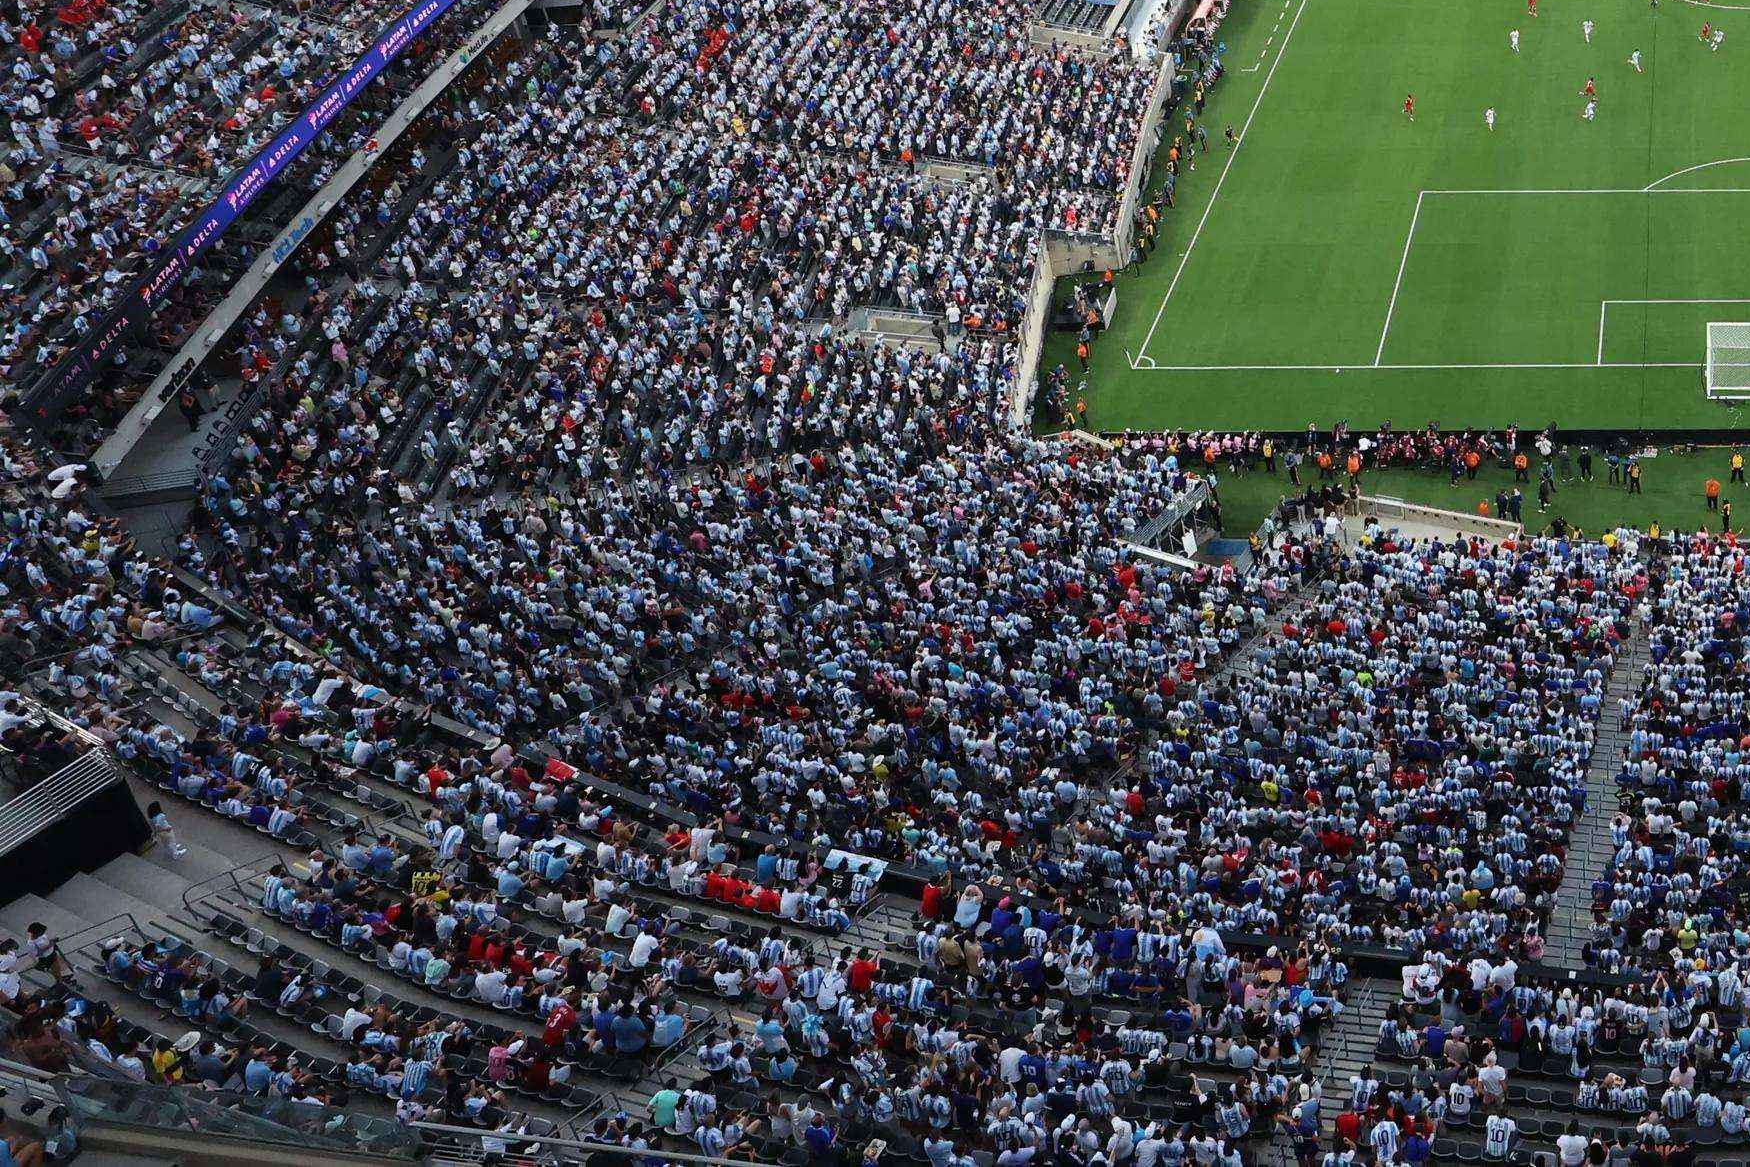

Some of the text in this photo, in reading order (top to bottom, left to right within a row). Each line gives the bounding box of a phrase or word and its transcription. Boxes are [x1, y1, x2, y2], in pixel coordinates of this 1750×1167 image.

[418, 1, 438, 21] DELTA
[386, 25, 407, 48] LATAM
[469, 34, 490, 56] MetLife
[351, 63, 372, 86] DELTA
[315, 91, 340, 117] LATAM
[275, 134, 299, 160] DELTA
[235, 168, 261, 197] LATAM
[193, 218, 219, 249] DELTA
[150, 257, 179, 291] LATAM
[100, 316, 129, 349] DELTA
[157, 357, 196, 403] verizon
[1357, 1090, 1367, 1103] 10
[1454, 1092, 1464, 1105] 10
[1379, 1131, 1390, 1145] 10
[1491, 1129, 1504, 1144] 10
